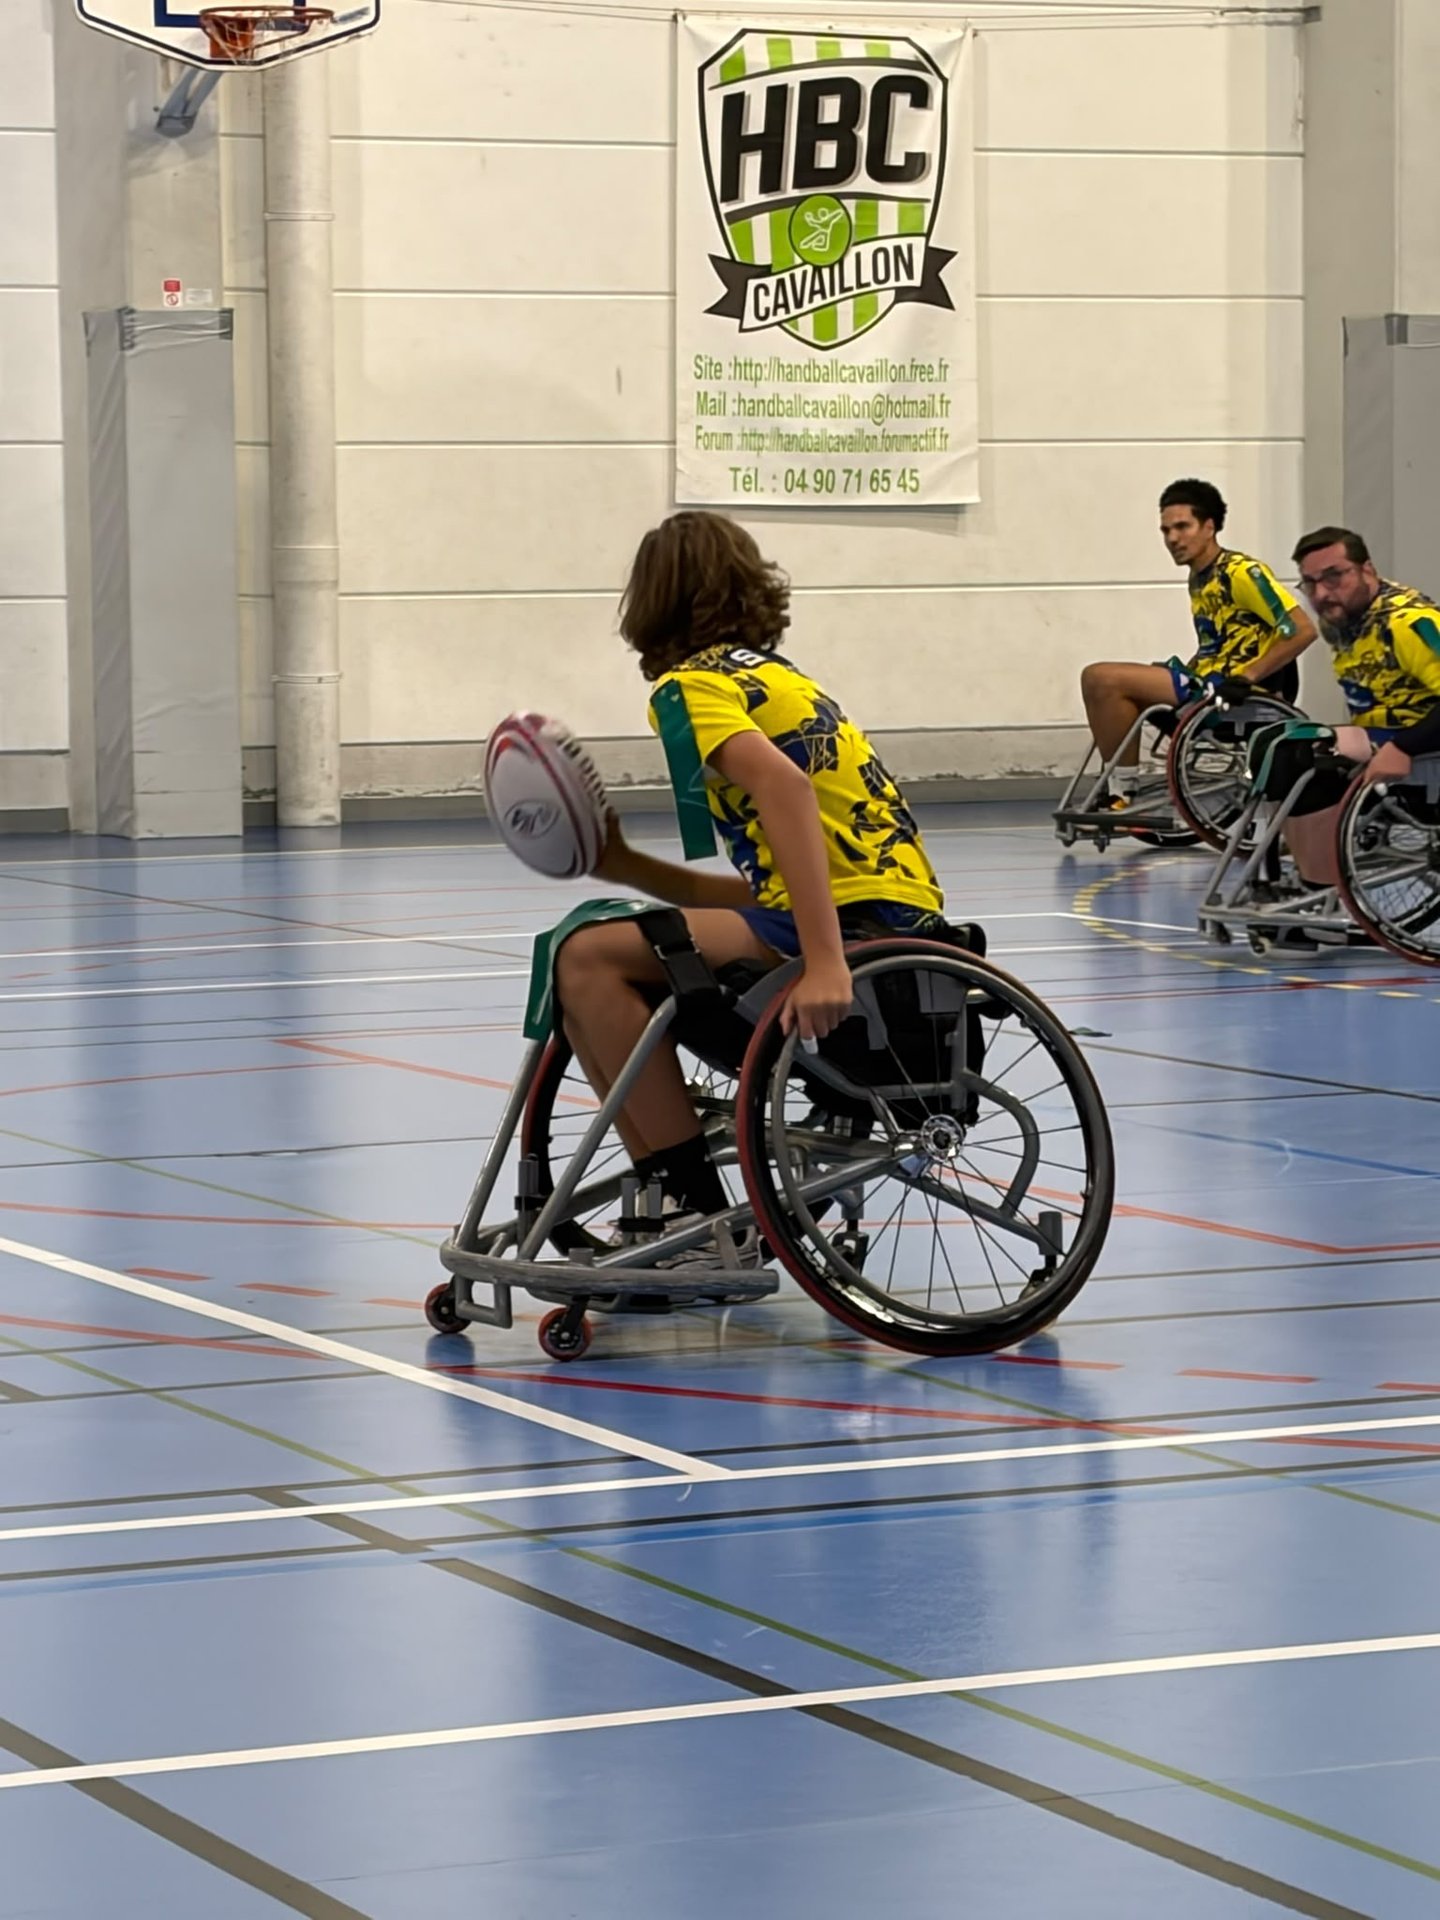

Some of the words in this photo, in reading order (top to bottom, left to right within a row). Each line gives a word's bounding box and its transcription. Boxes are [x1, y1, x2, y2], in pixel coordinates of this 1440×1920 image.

[719, 75, 933, 205] HBC
[752, 243, 914, 322] CAVAILLON
[694, 354, 723, 380] Site
[696, 391, 726, 417] Mail
[695, 425, 733, 451] Forum
[729, 467, 764, 493] Tél.
[784, 468, 808, 493] 04
[813, 468, 835, 493] 90
[843, 468, 862, 493] 71
[869, 468, 891, 493] 65
[897, 468, 920, 493] 45
